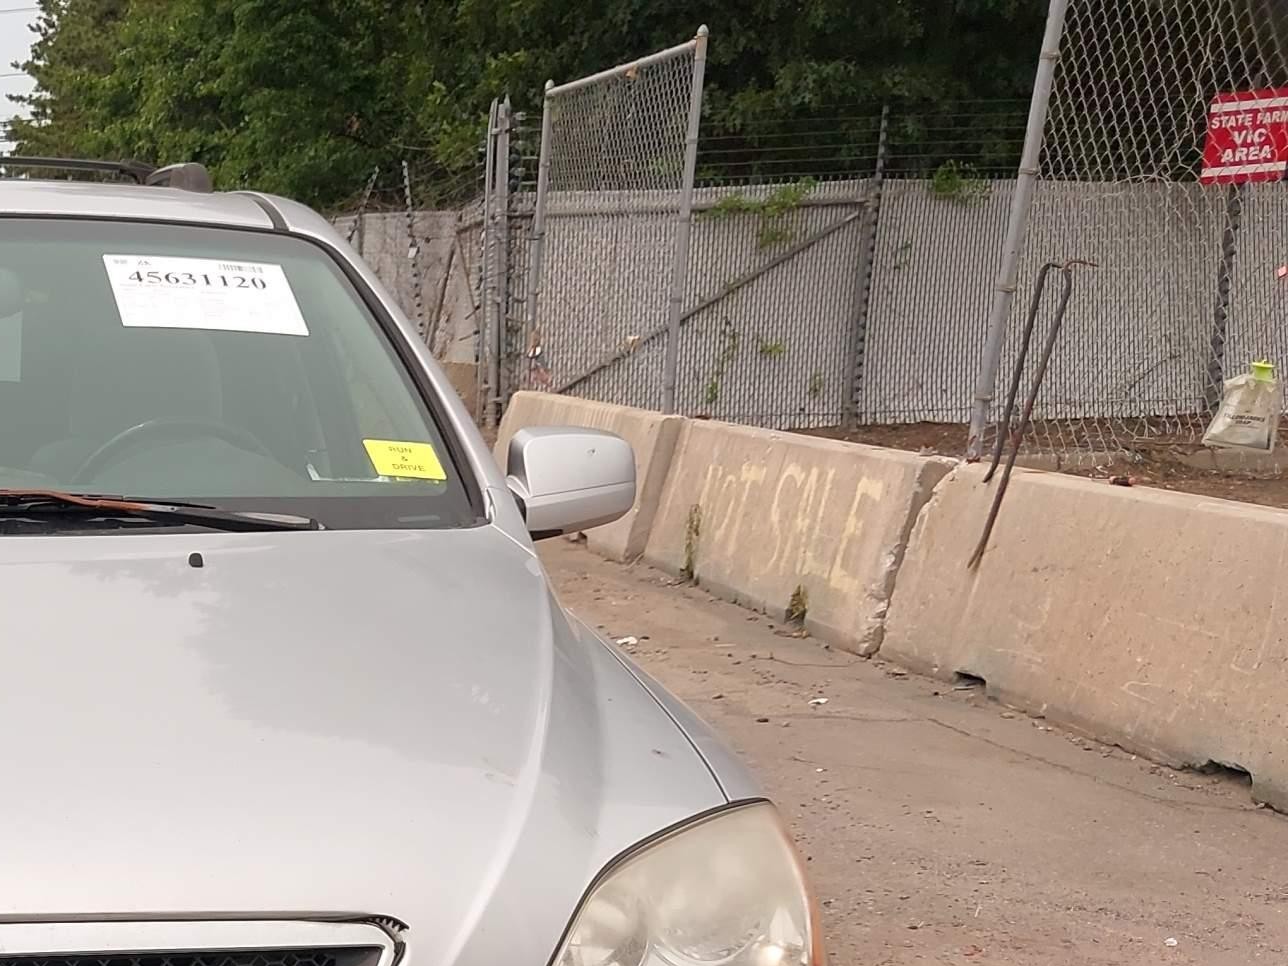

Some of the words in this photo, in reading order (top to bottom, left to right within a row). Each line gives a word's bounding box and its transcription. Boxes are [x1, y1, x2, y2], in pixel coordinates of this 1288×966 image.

[1212, 113, 1253, 129] STATE
[1233, 128, 1267, 144] VIC
[1220, 145, 1272, 163] AREA
[128, 270, 267, 290] 45631120
[388, 446, 412, 454] RUN
[392, 463, 426, 472] DRIVE
